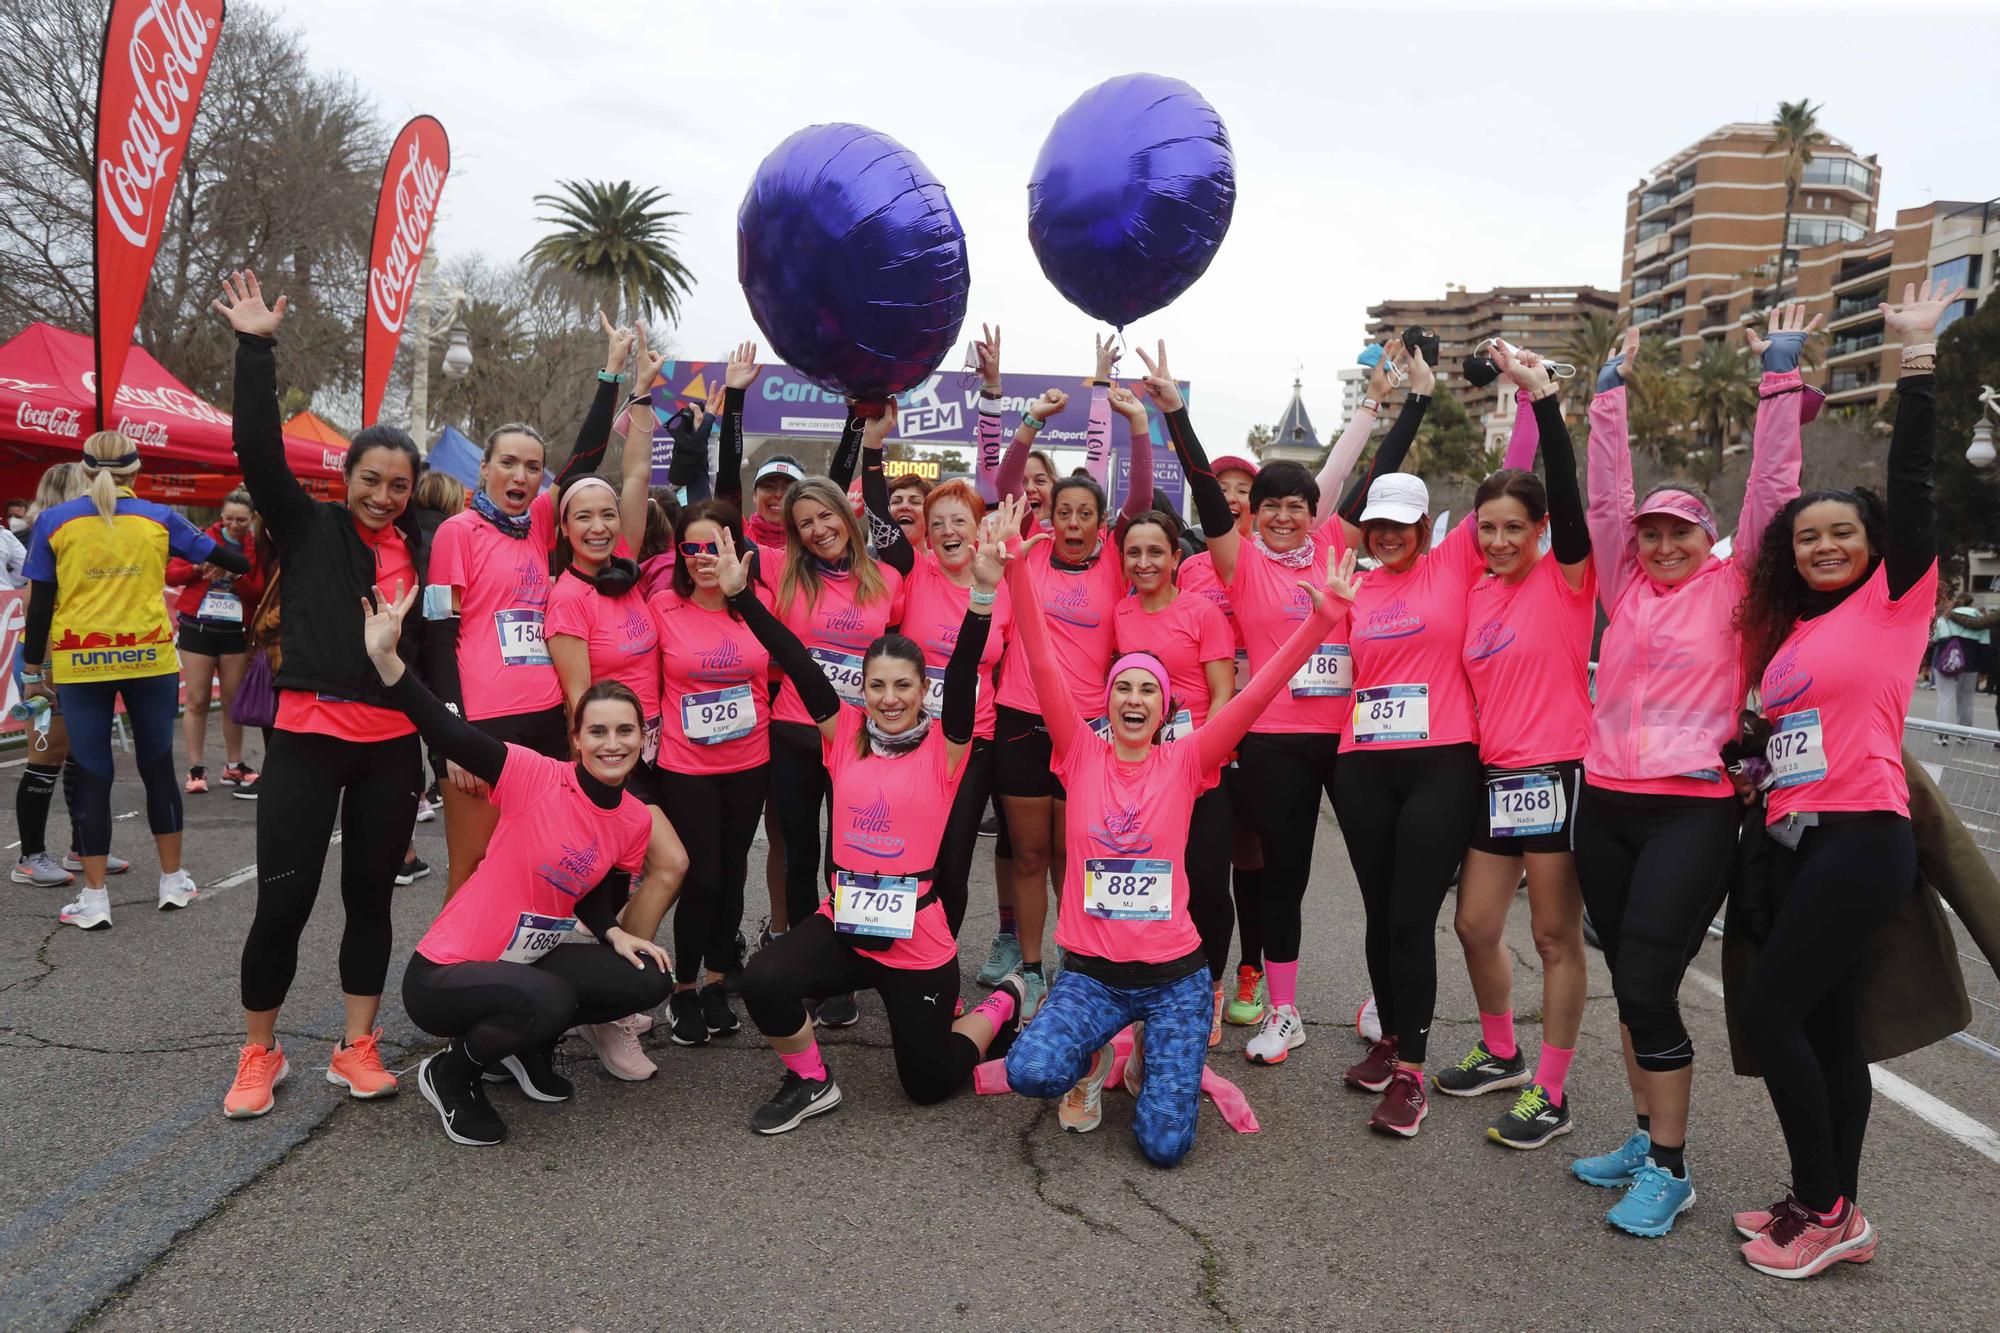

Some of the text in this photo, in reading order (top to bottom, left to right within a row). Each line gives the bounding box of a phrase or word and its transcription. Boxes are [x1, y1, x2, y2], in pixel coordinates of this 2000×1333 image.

[100, 0, 208, 247] Coca-Cola
[370, 132, 440, 333] Coca-Cola
[16, 401, 82, 438] Coca-Cola
[904, 405, 956, 434] FEM
[118, 415, 169, 447] Coca-Cola
[208, 600, 236, 611] 2058
[826, 617, 865, 631] velas
[71, 648, 157, 667] runners
[702, 654, 743, 669] velas
[72, 665, 100, 674] CIUTAT
[104, 664, 117, 672] DE
[701, 702, 739, 724] 926
[1370, 700, 1407, 720] 851
[712, 725, 730, 733] ESPE
[1768, 731, 1809, 763] 1972
[1502, 789, 1551, 813] 1268
[852, 816, 893, 834] velas
[1516, 815, 1536, 824] Nadia
[1107, 875, 1152, 896] 882
[850, 889, 905, 914] 1705
[522, 931, 562, 951] 1869
